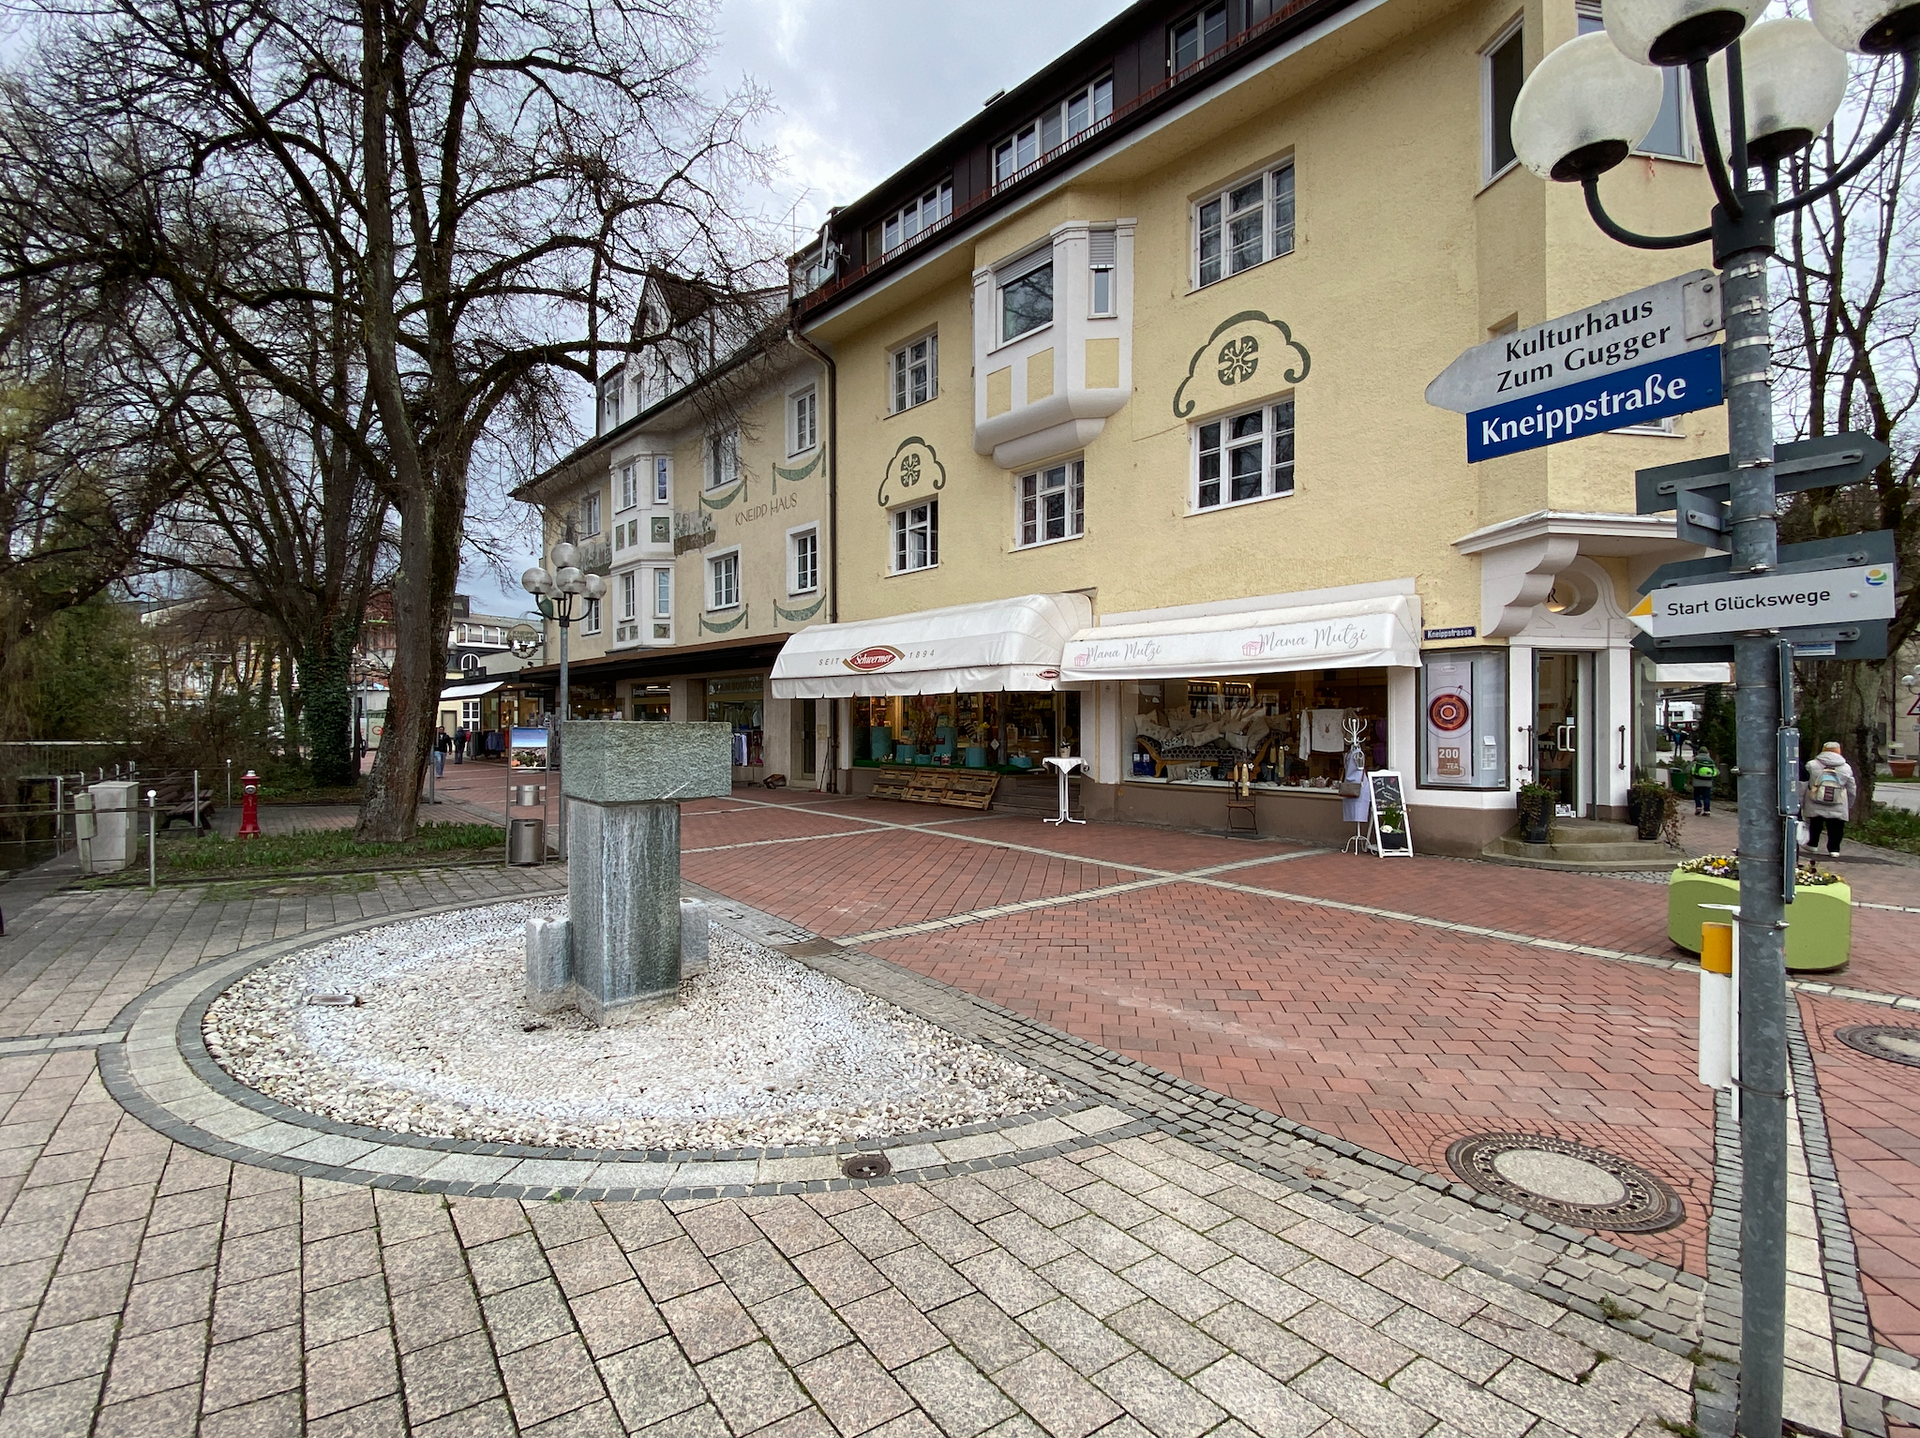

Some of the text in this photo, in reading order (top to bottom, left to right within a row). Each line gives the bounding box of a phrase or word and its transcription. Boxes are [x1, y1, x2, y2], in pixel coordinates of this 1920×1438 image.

[1506, 300, 1654, 362] Kulturhaus
[1496, 325, 1671, 393] Zum Gugger
[1481, 373, 1687, 446] Kneippstraße
[770, 492, 797, 516] HAUS
[1667, 590, 1830, 616] Start Glückswege
[1258, 624, 1368, 654] Mama Mutzi
[1427, 629, 1473, 639] Kneippstrasse
[818, 649, 935, 666] SEIT Schwermer 1894
[1085, 640, 1162, 665] Mama Mutzi
[1438, 749, 1459, 758] 200
